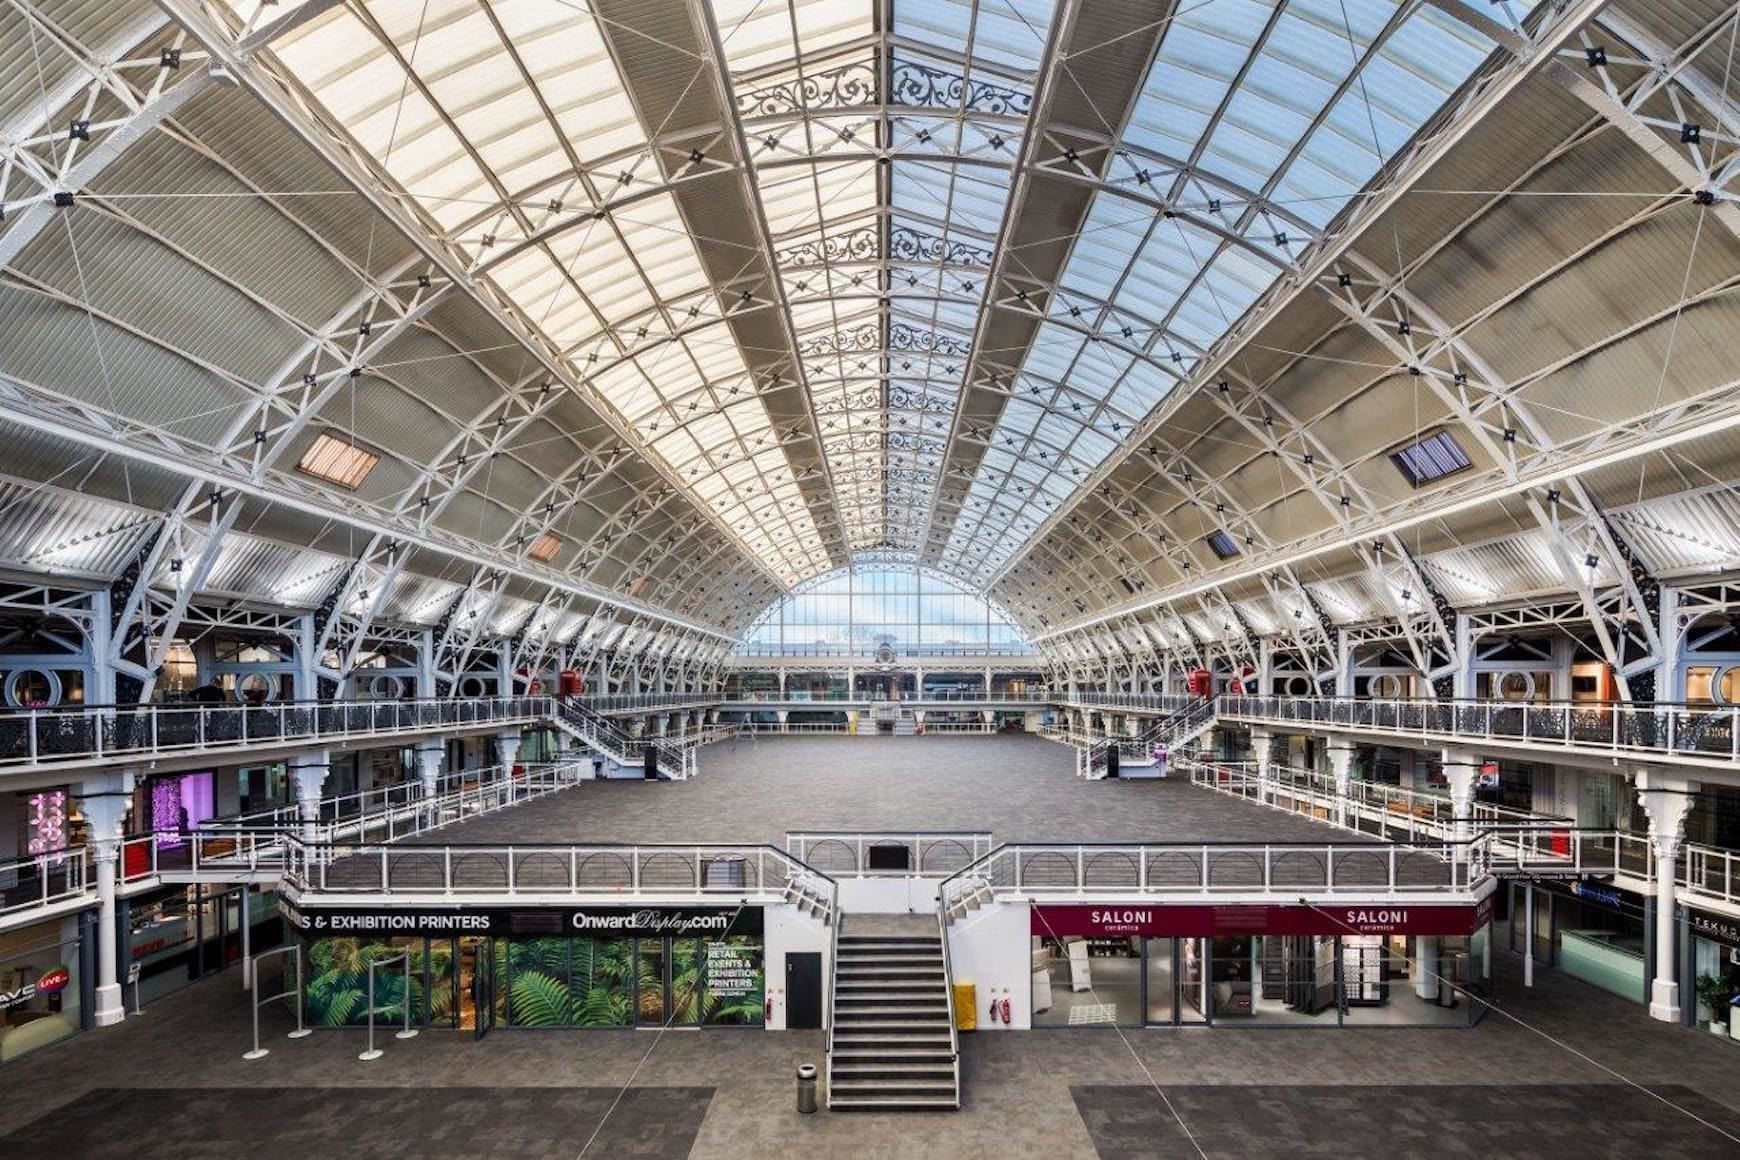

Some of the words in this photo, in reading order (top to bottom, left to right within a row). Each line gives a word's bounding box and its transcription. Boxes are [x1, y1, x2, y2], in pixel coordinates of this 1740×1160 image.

[1091, 910, 1153, 923] SALONI
[1346, 910, 1408, 923] SALONI
[314, 915, 327, 929] &
[331, 915, 415, 929] EXHIBITION
[419, 915, 490, 929] PRINTERS
[708, 950, 739, 959] RETAIL
[708, 959, 743, 968] EVENTS
[708, 969, 759, 978] EXHIBITION
[708, 978, 753, 988] PRINTERS
